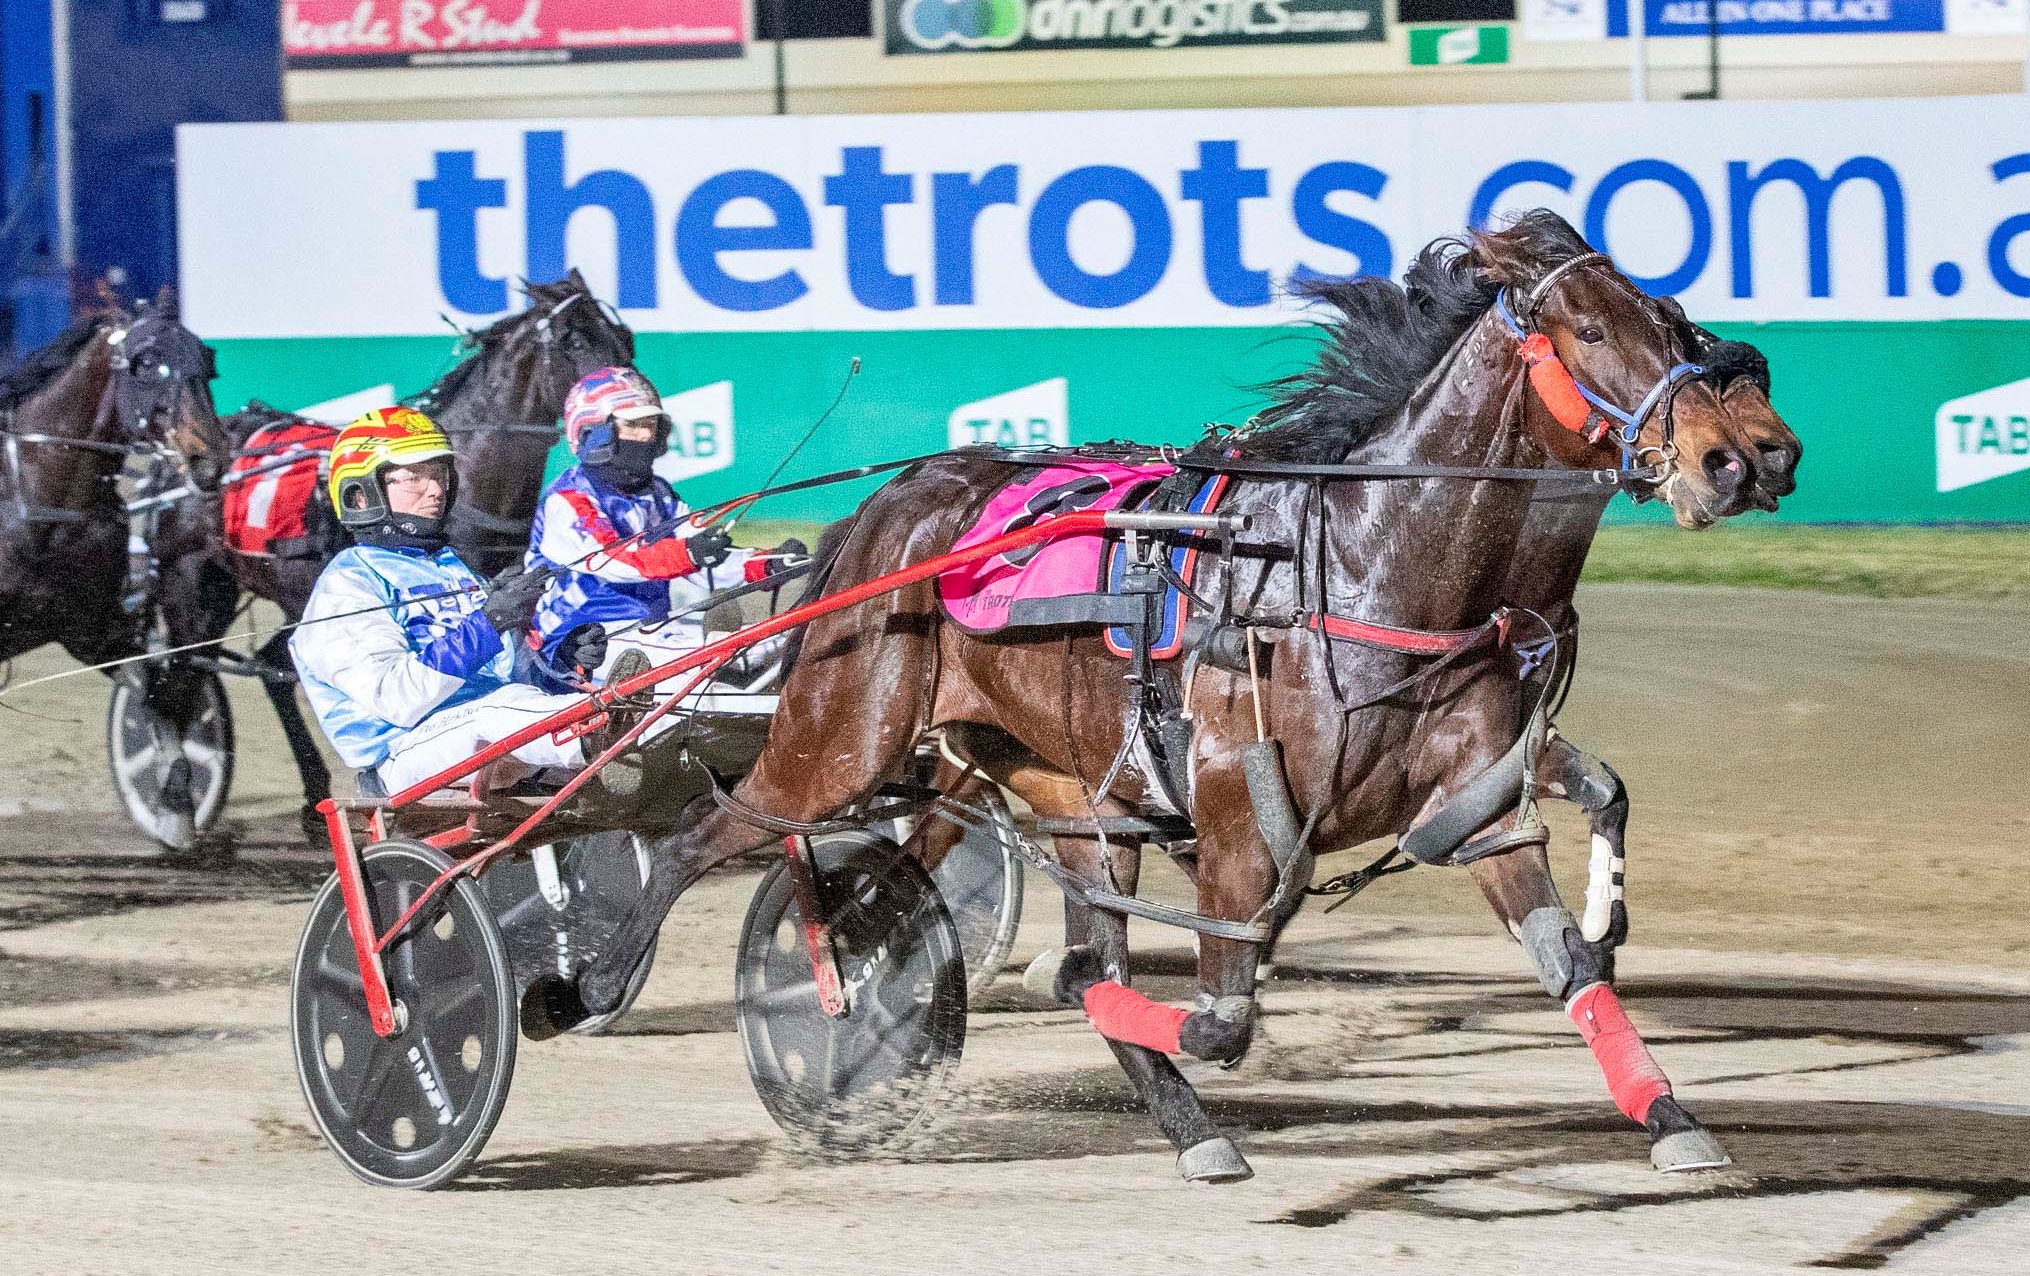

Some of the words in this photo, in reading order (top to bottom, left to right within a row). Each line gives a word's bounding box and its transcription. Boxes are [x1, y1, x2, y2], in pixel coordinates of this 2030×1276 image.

[415, 129, 2030, 315] thetrotscom.
[668, 421, 717, 456] AB
[1951, 414, 2028, 454] TAB
